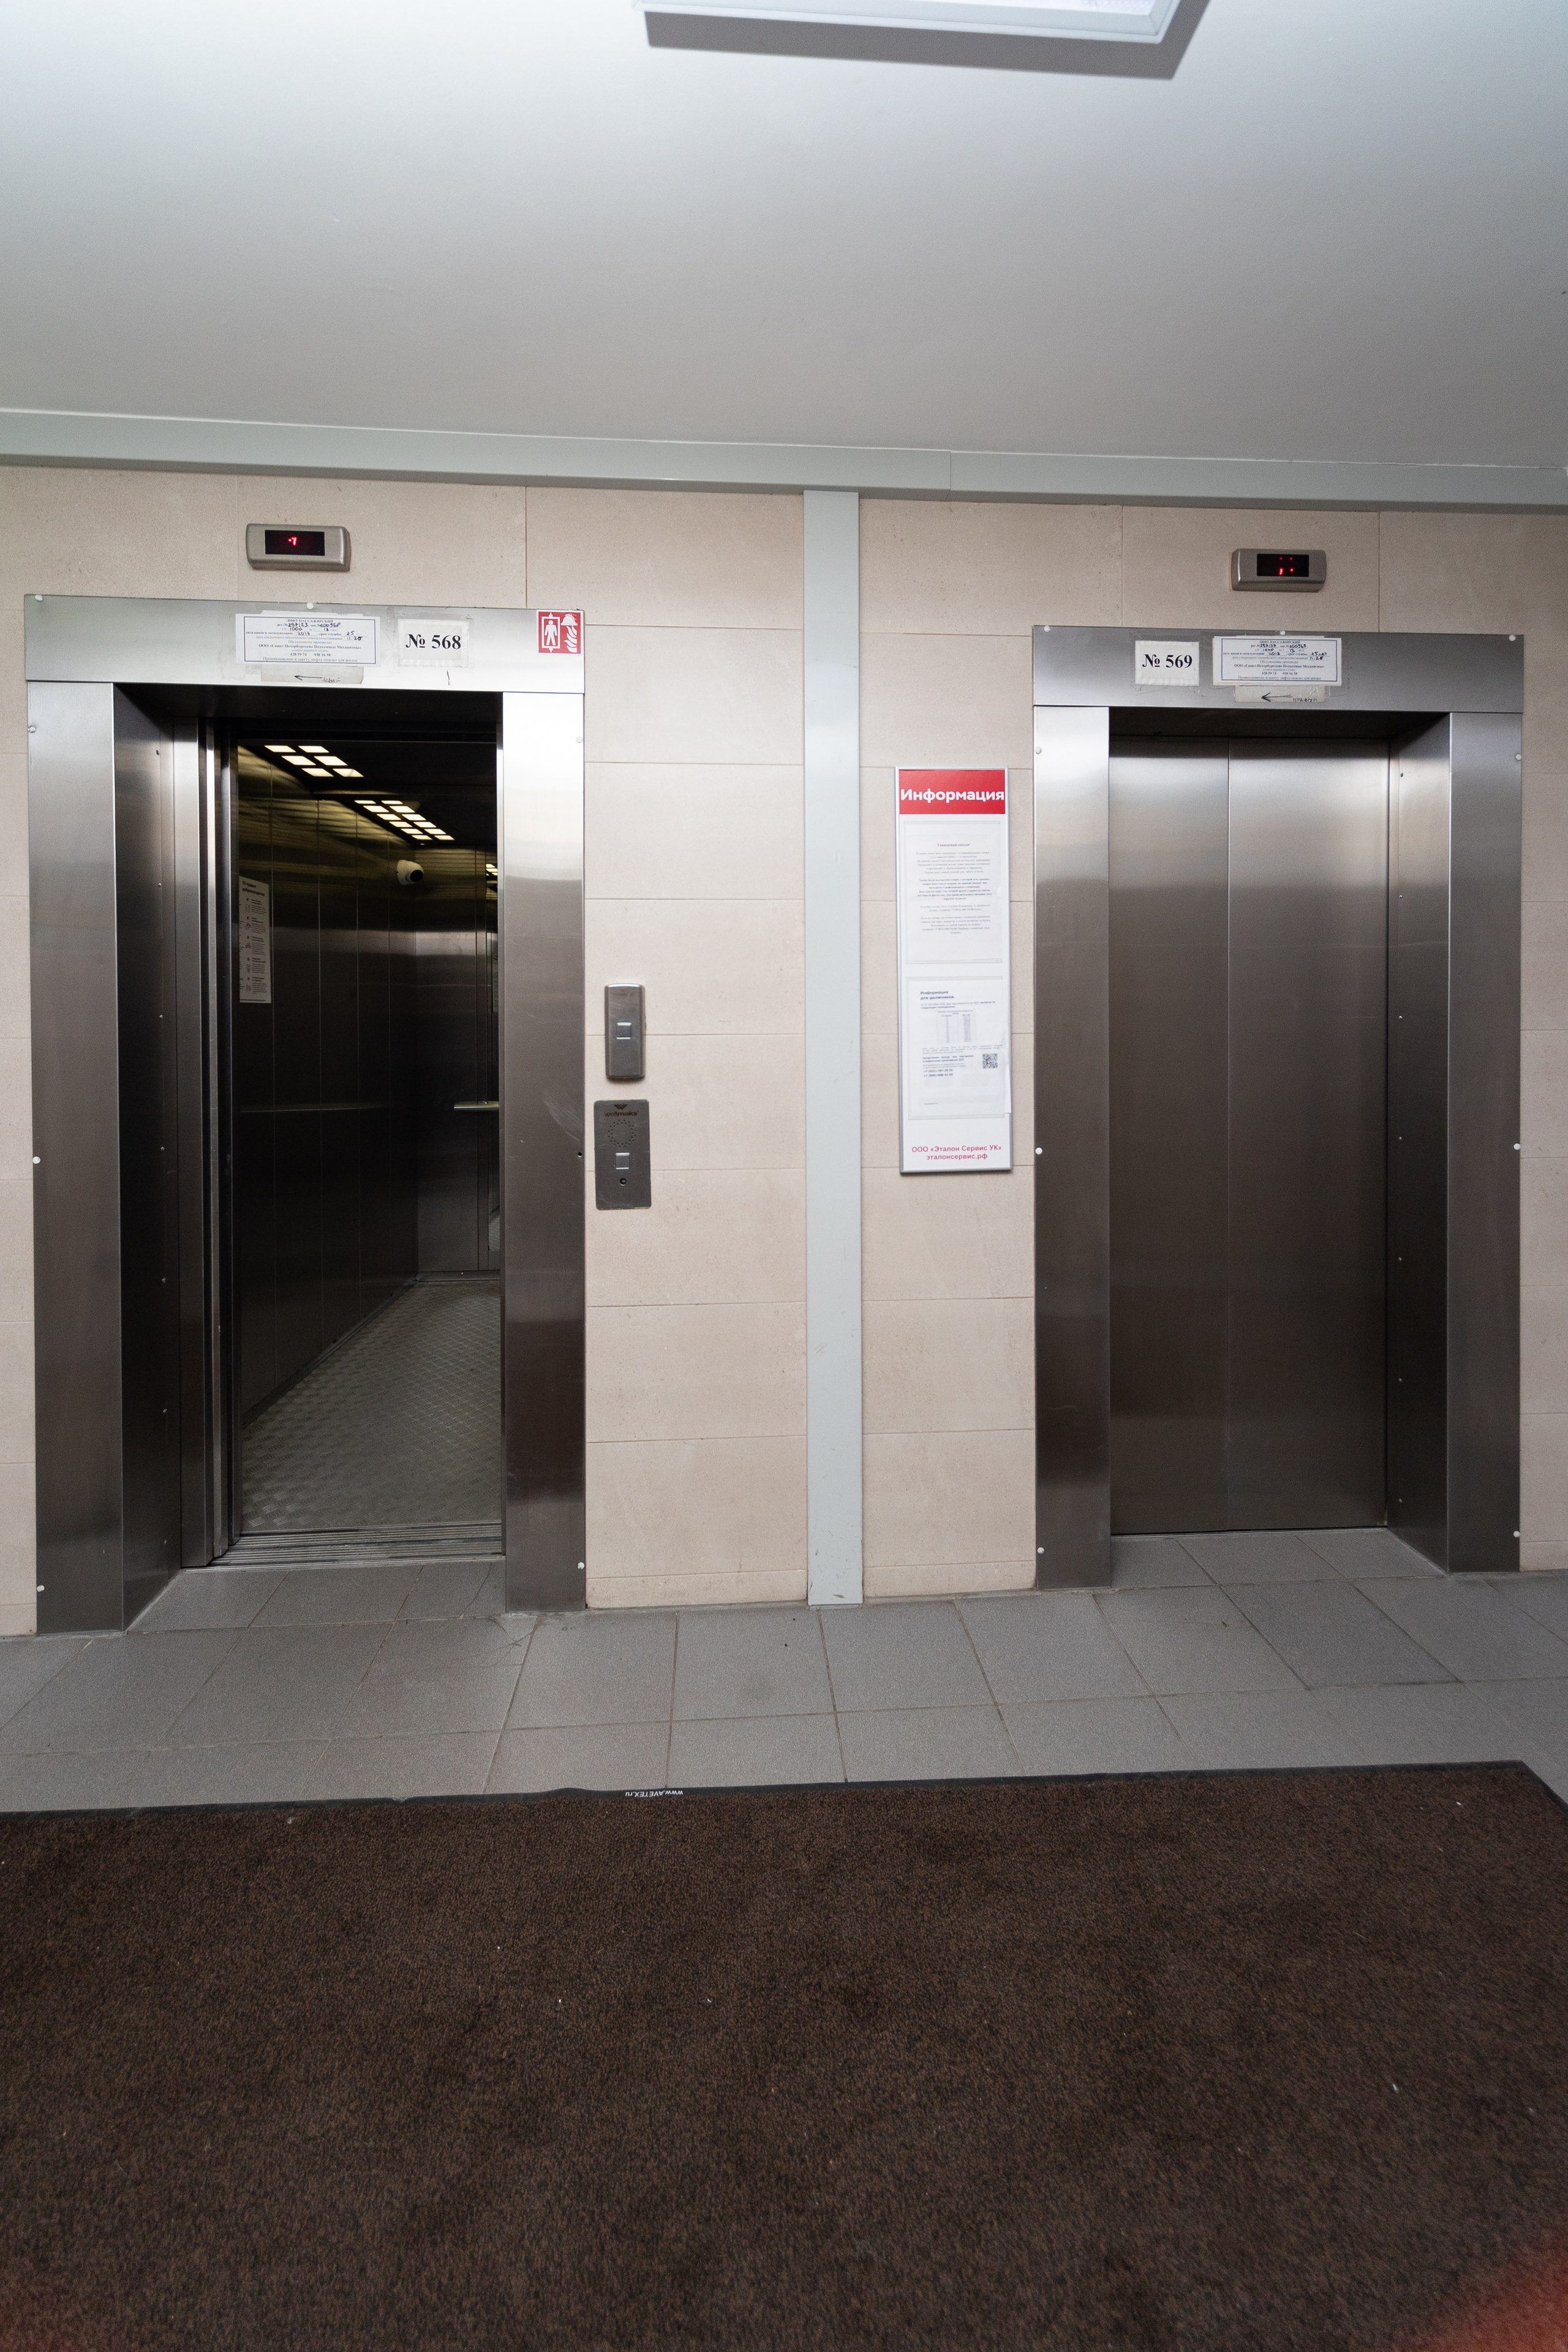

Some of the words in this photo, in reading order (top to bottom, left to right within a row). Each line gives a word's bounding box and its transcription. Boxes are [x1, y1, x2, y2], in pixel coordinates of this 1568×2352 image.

[405, 634, 425, 648] №
[432, 635, 461, 649] 568
[1142, 654, 1160, 667] №
[1166, 655, 1193, 668] 569
[900, 788, 1005, 804] Информация
